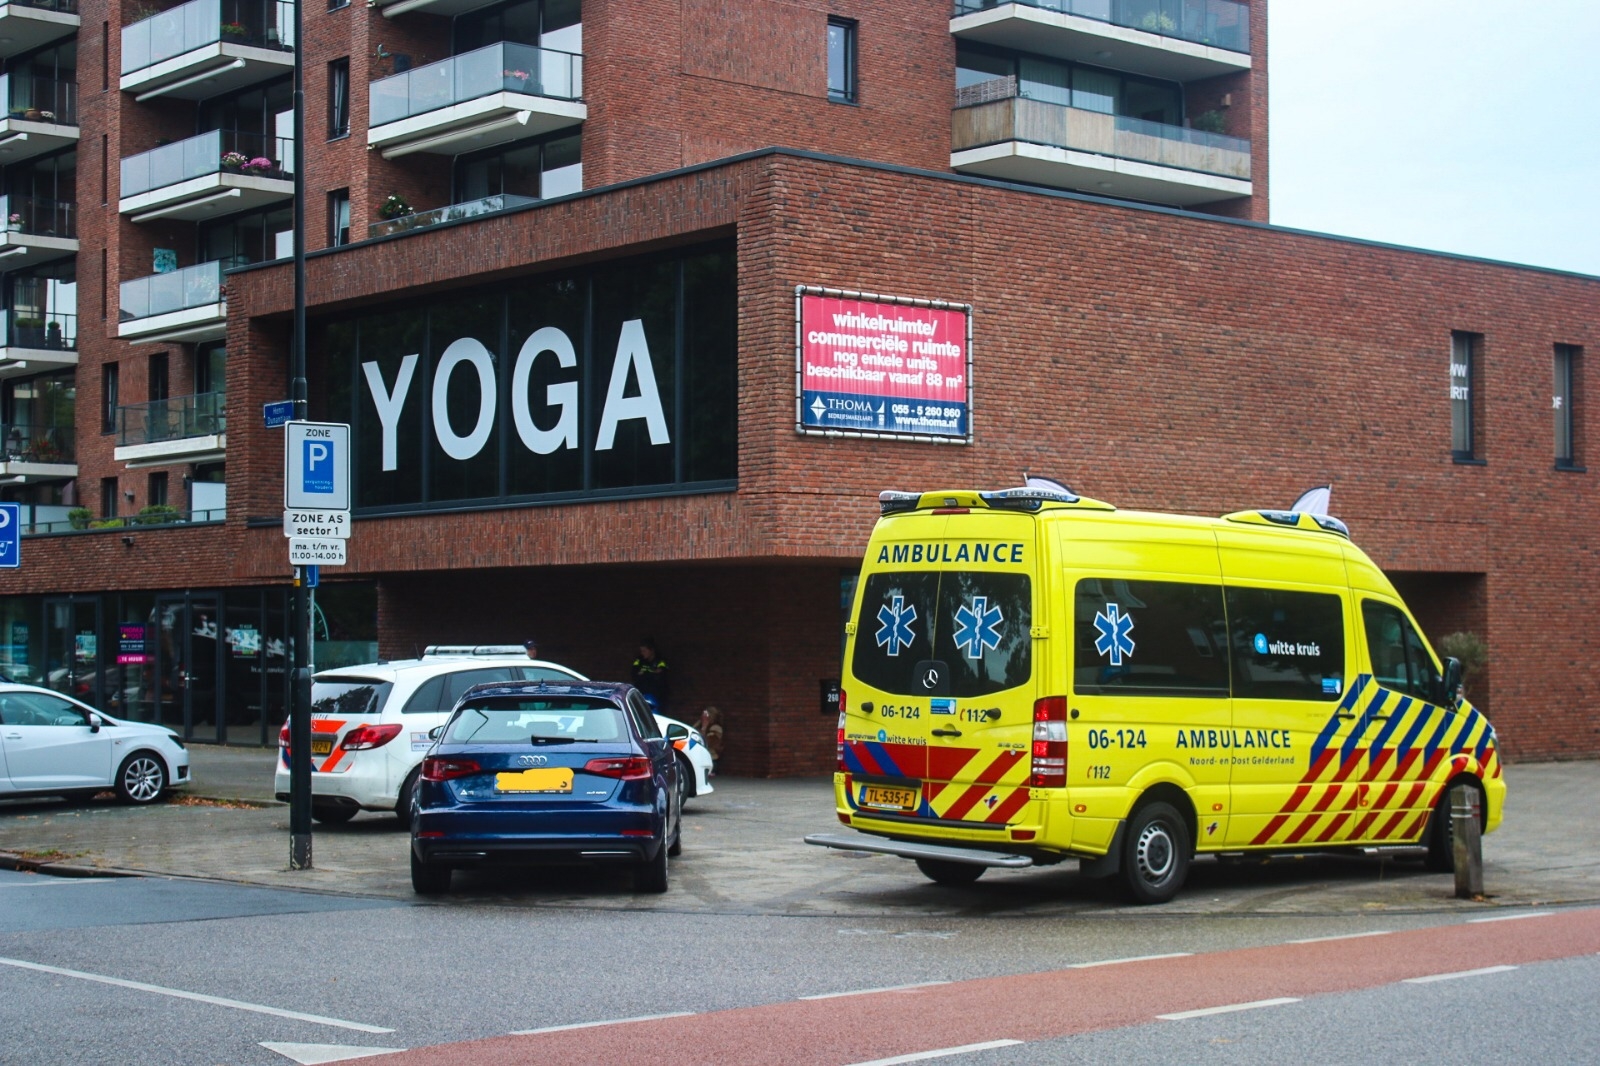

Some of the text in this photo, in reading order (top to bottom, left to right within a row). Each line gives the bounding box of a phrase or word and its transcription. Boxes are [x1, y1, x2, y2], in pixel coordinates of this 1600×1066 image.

[832, 312, 938, 336] winkelruimte/
[807, 330, 961, 357] commerciële ruimte
[833, 350, 937, 371] nog enkele units
[806, 362, 886, 382] beschikbaar
[888, 370, 923, 386] vanaf
[925, 374, 943, 387] 88
[361, 319, 670, 471] YOGA
[827, 398, 872, 412] THOMA
[891, 403, 909, 414] 055
[917, 406, 923, 415] 5
[924, 405, 942, 417] 260
[943, 407, 961, 418] 860
[895, 415, 957, 428] www.thoma.nl
[305, 428, 331, 438] ZONE
[309, 443, 328, 472] P
[292, 513, 344, 524] ZONE AS
[296, 526, 339, 535] sector 1
[312, 542, 328, 550] t/m
[877, 543, 1024, 564] AMBULANCE
[291, 551, 344, 560] 11.00-14.00 h
[1269, 639, 1320, 658] witte kruis
[881, 704, 920, 719] 06-124
[886, 733, 927, 746] witte kruis
[1088, 728, 1147, 749] 06-124
[1176, 729, 1291, 748] AMBULANCE
[1189, 756, 1217, 766] Noord-
[1252, 755, 1295, 765] Gelderland
[869, 789, 910, 805] TL-535-F
